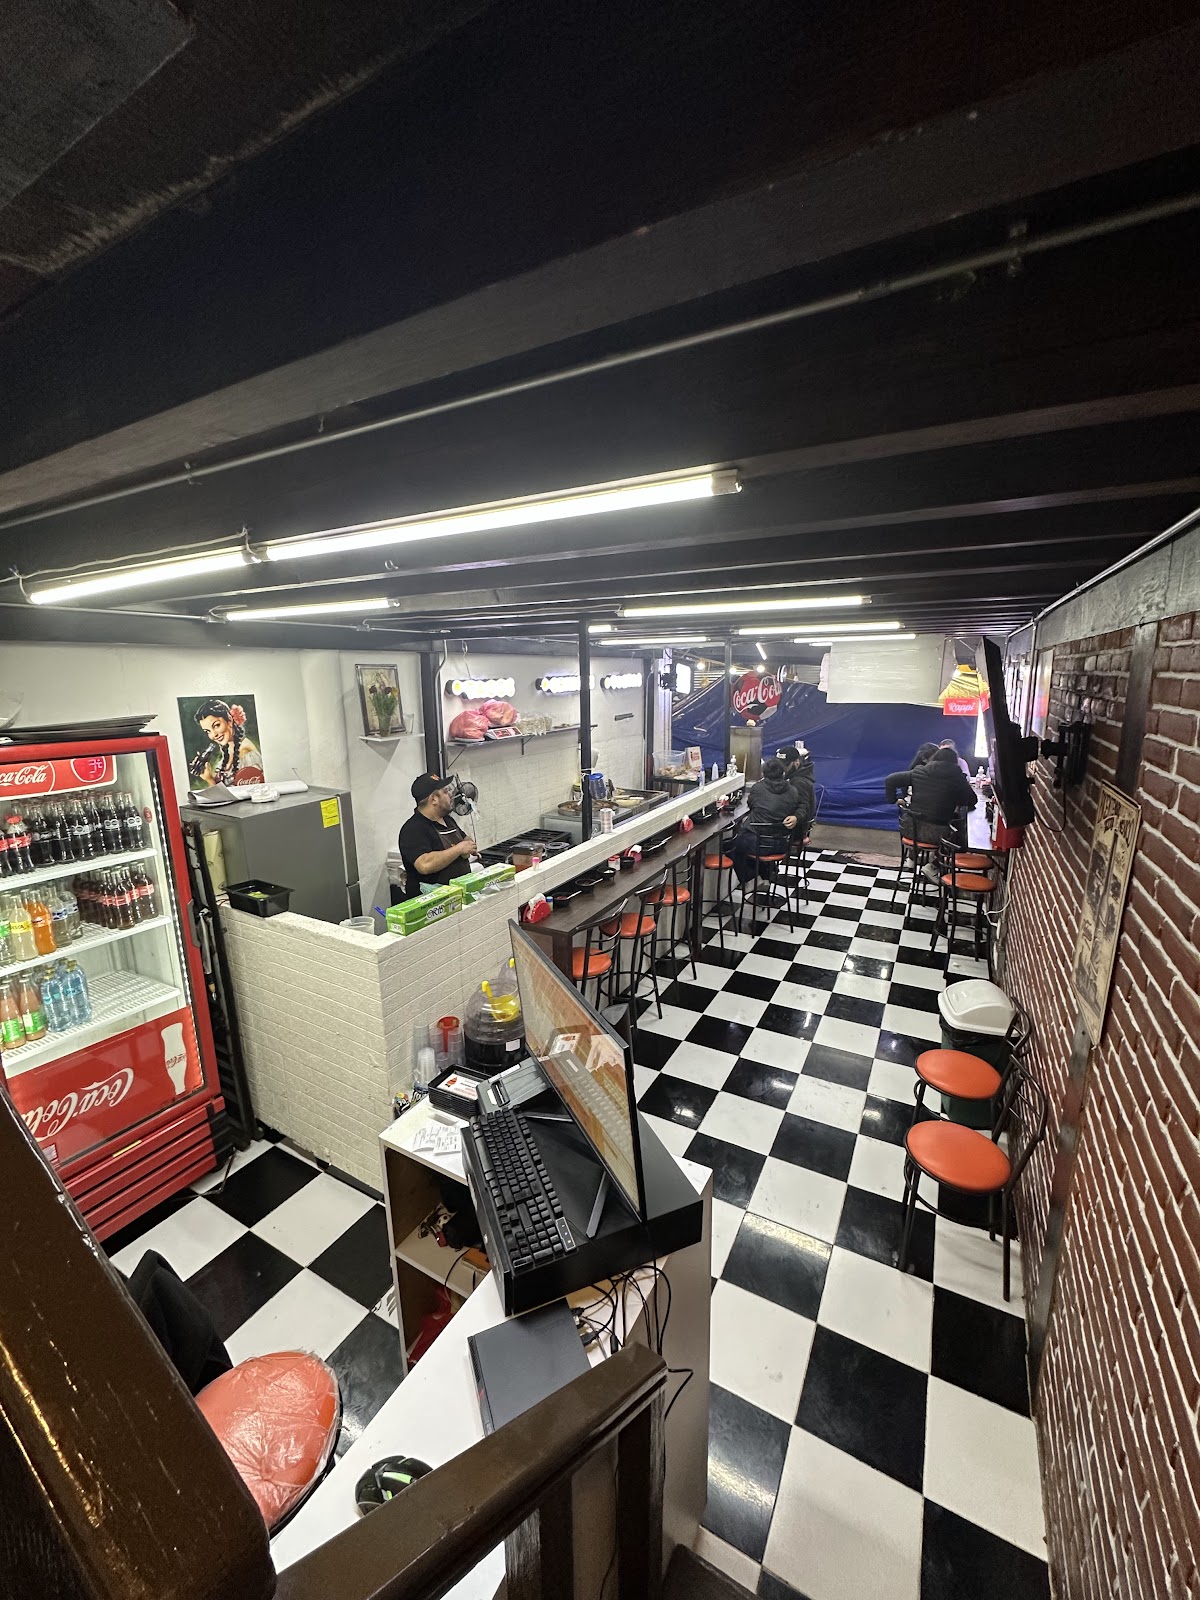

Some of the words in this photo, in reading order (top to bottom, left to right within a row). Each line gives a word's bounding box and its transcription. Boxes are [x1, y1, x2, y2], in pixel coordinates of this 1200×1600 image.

[733, 676, 782, 713] Coca-Cola
[948, 702, 976, 713] Rappi
[0, 765, 49, 786] ca-Cola
